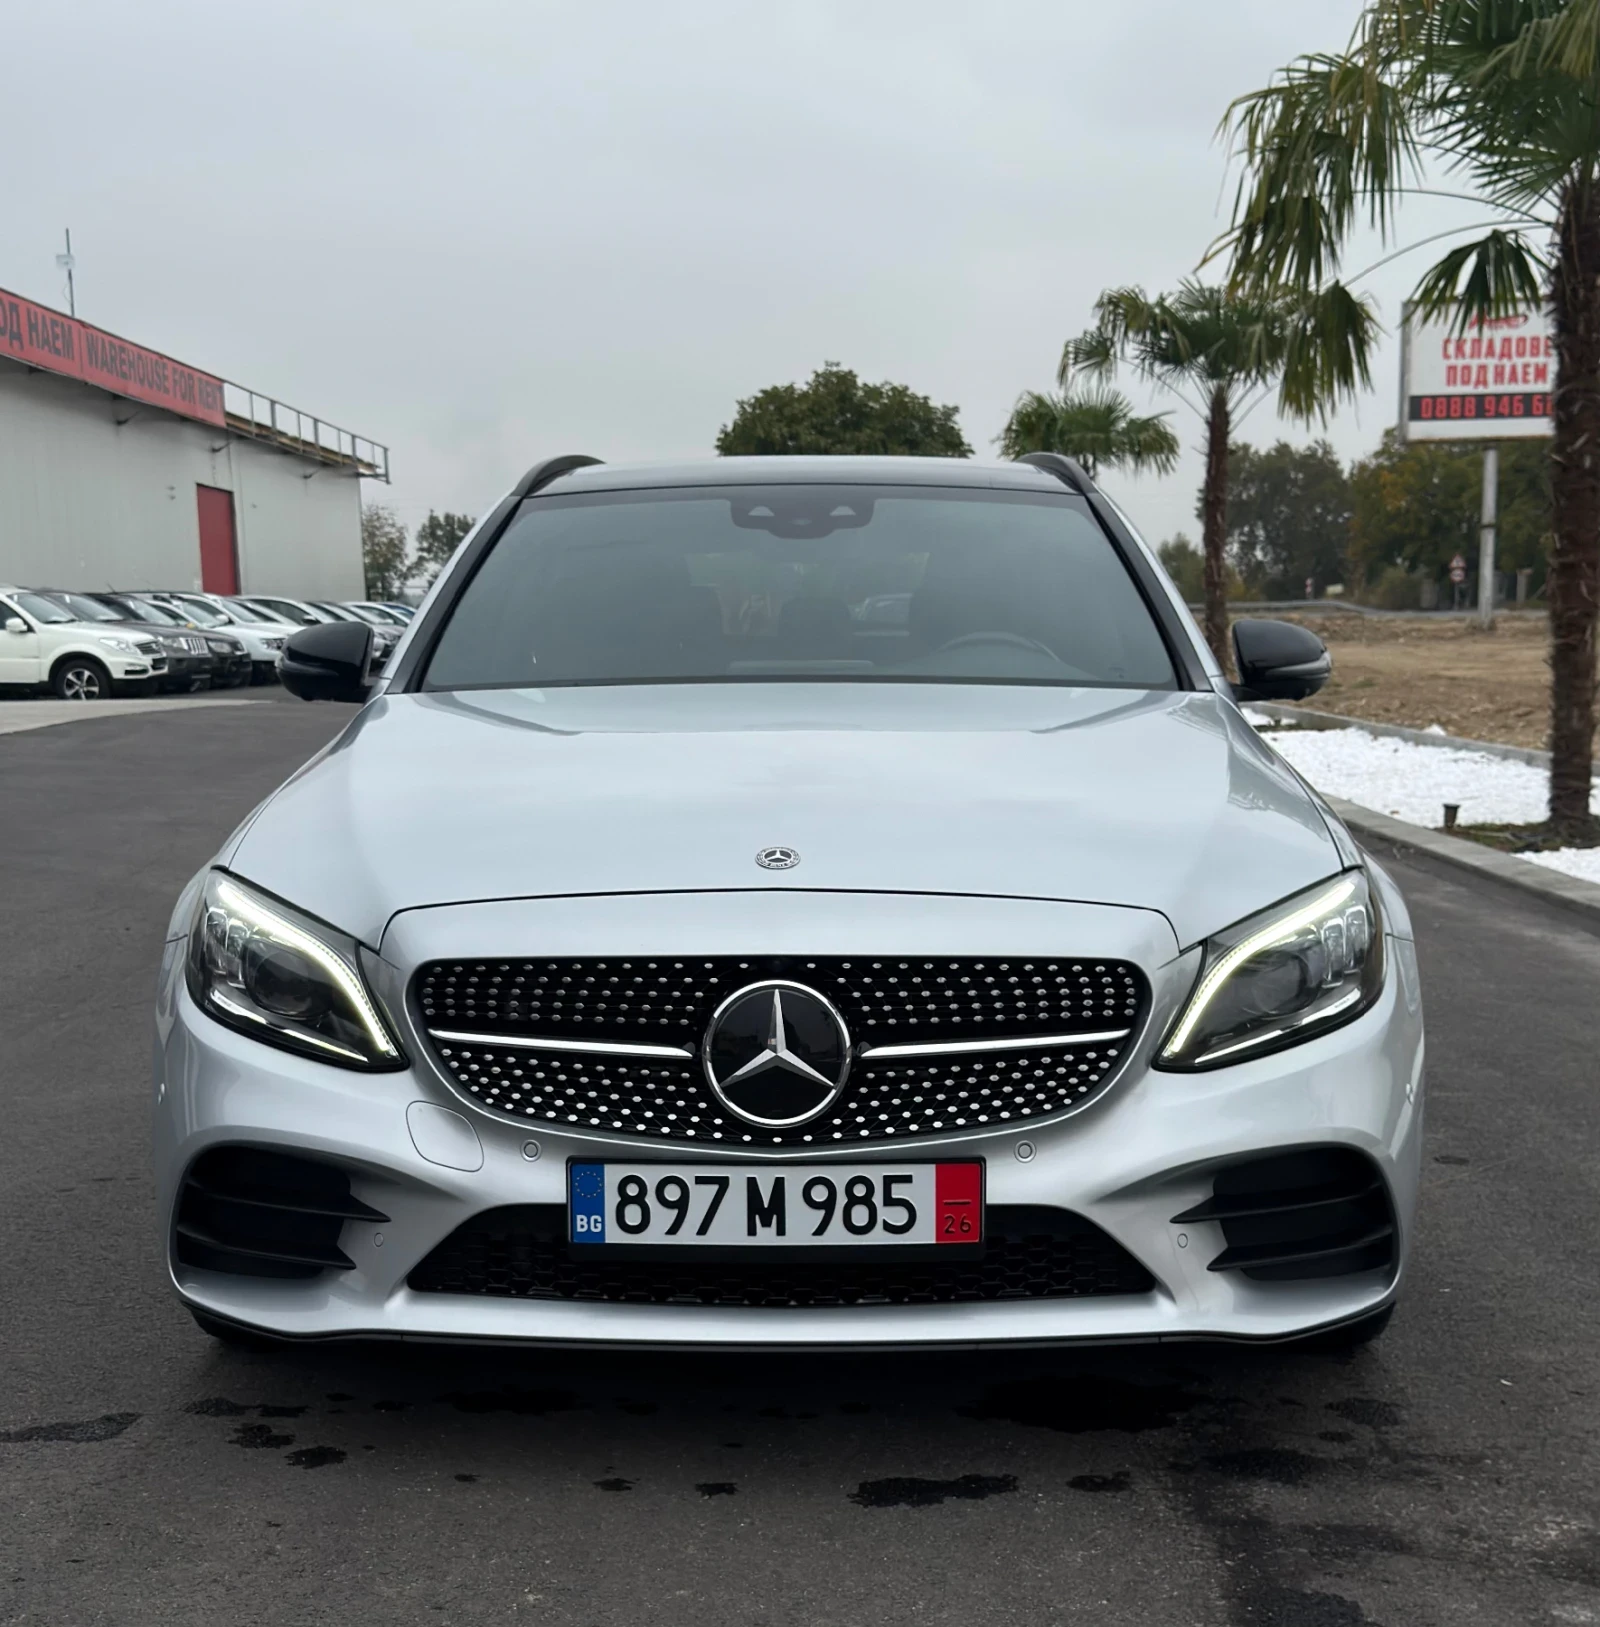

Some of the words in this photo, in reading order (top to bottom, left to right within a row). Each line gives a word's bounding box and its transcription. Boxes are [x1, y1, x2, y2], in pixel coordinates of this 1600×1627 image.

[27, 307, 75, 361] НАЕМ
[86, 331, 169, 395] WAREHOUSE
[171, 366, 196, 404] FOR
[1446, 364, 1489, 389] ПОД
[1494, 363, 1548, 385] НАЕМ
[1420, 396, 1476, 419] 0888
[1484, 395, 1524, 417] 946
[576, 1214, 602, 1233] BG
[615, 1174, 730, 1236] 897
[746, 1176, 786, 1236] M
[802, 1174, 917, 1236] 985
[944, 1213, 971, 1234] 26
